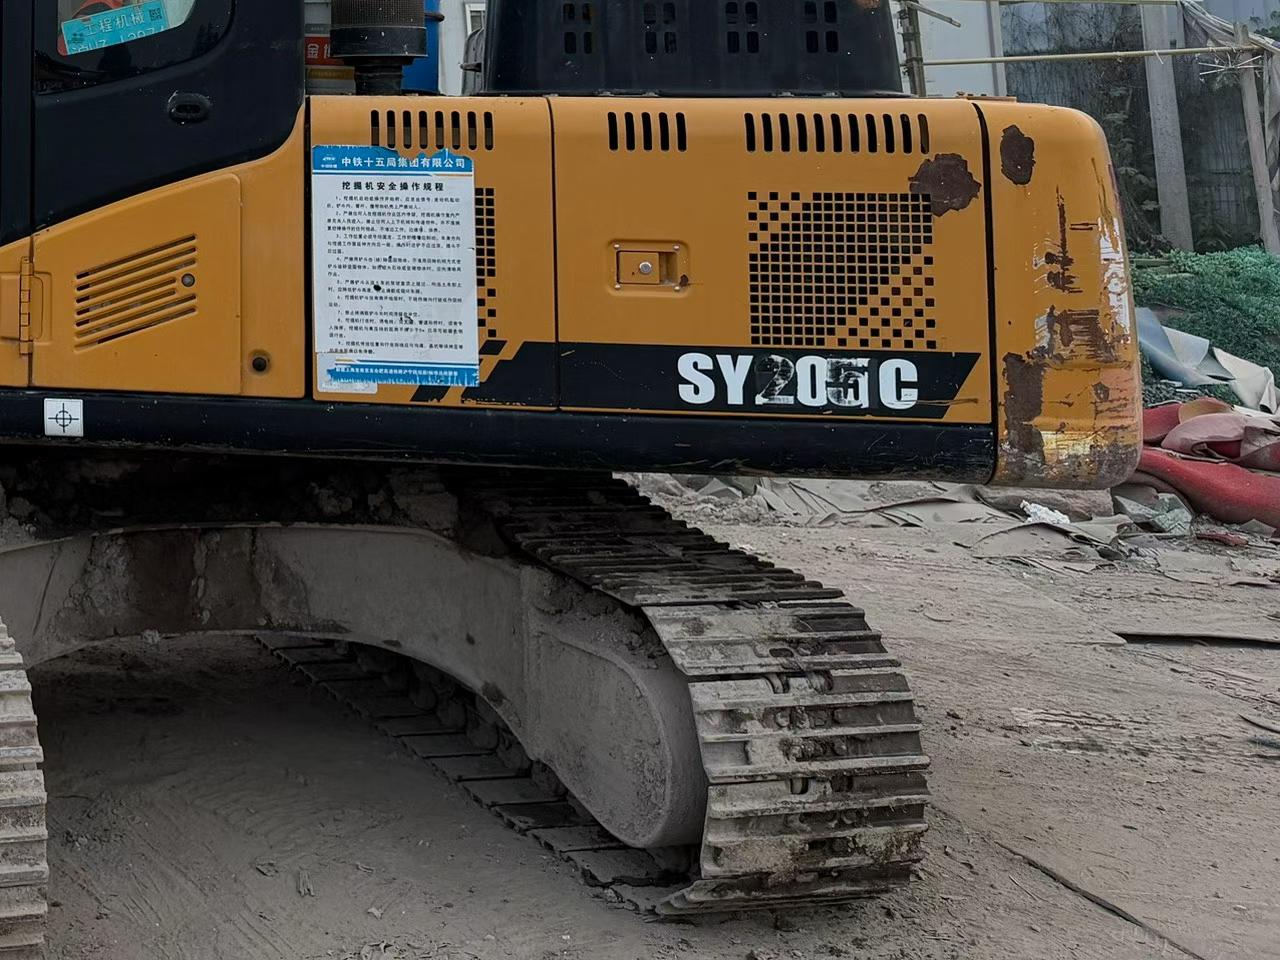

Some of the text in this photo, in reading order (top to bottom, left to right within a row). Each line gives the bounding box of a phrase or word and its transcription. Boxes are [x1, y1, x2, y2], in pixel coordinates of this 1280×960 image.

[84, 8, 144, 36] 工程机械
[341, 156, 466, 168] 中铁十五局集团有限公司
[341, 181, 445, 192] 挖掘机安全操作规程
